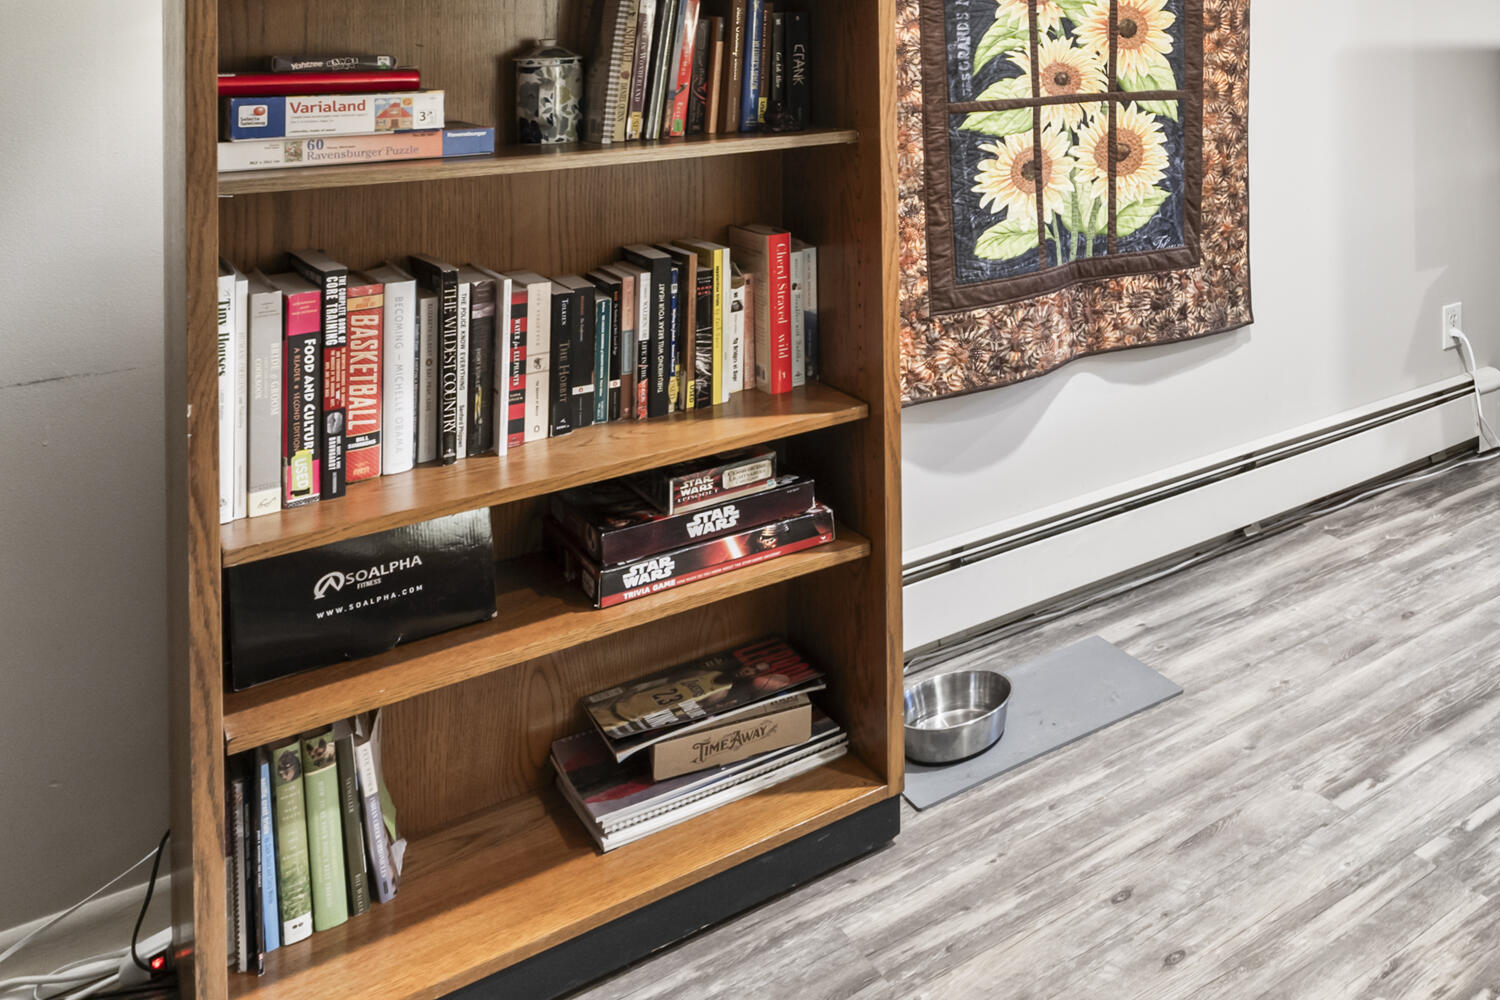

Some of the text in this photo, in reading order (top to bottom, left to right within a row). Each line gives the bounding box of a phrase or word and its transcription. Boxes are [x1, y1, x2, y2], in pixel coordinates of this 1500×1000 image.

[634, 51, 646, 103] WONDERLAND
[290, 99, 366, 114] Varialand
[306, 139, 324, 151] 60
[306, 145, 419, 161] Ravensburger Puzzle
[326, 276, 338, 302] CORE
[338, 275, 347, 286] THE
[657, 283, 665, 303] HEART
[337, 287, 347, 316] COMPLETE
[657, 303, 665, 320] YOUR
[775, 243, 789, 359] Cheryl Strayed wild
[325, 303, 338, 346] TRAINING
[337, 317, 347, 334] BOOK
[513, 318, 521, 340] WATER
[303, 338, 317, 373] FOOD
[443, 285, 457, 433] THE WILDEST COUNTRY
[347, 313, 379, 431] BASKETBALL
[394, 296, 405, 454] BECOMING MICHELLE OBAMA
[458, 352, 466, 391] EVERYTHING
[512, 351, 520, 387] ELEPHANTS
[559, 340, 570, 403] THE HOBBIT
[303, 375, 315, 402] AND
[293, 392, 301, 421] SECOND
[292, 422, 301, 451] EDITION
[293, 456, 309, 490] USED
[680, 475, 714, 490] STAR
[680, 482, 714, 497] WARS
[686, 505, 740, 528] STAR
[687, 516, 740, 538] WARS
[345, 555, 423, 585] SOALPHA
[623, 556, 675, 579] STAR
[623, 565, 675, 589] WARS
[357, 578, 382, 590] FITNESS
[623, 578, 676, 601] TRIVIA GAME
